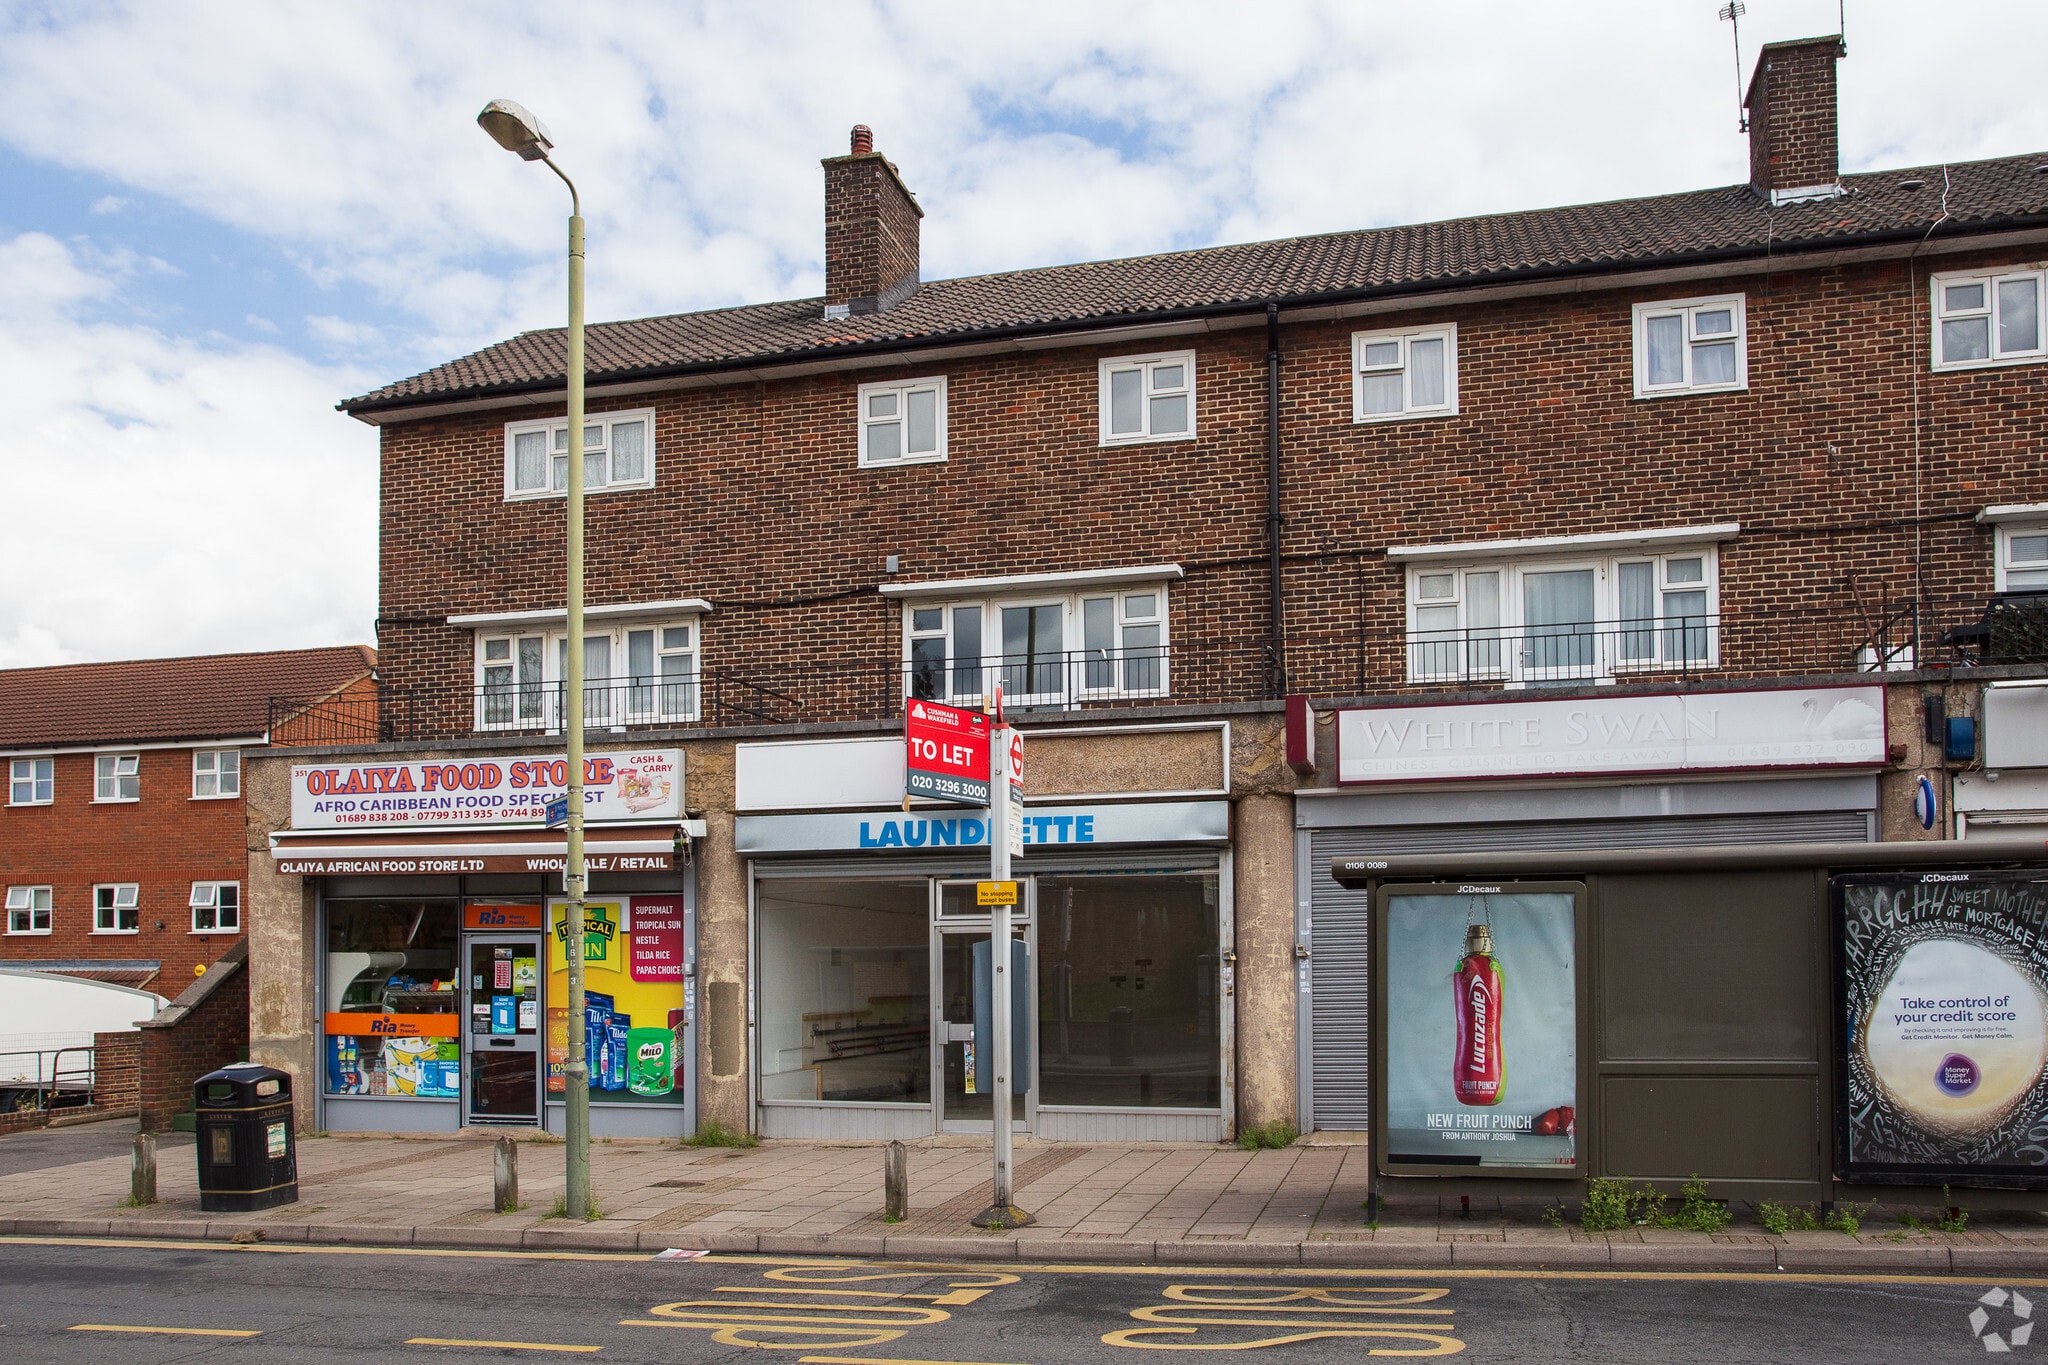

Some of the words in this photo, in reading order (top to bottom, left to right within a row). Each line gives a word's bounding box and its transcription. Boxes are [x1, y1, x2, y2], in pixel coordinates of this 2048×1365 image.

[927, 708, 954, 719] CUSHMAN
[927, 714, 959, 726] WAKEFIELD
[1360, 717, 1542, 752] WHITE
[1566, 708, 1720, 746] SWAN
[911, 737, 937, 760] TO
[943, 743, 973, 767] LET
[1728, 746, 1782, 758] 01689
[1837, 742, 1868, 754] 090
[630, 755, 655, 764] CASH
[656, 755, 664, 763] &
[1361, 759, 1440, 772] CHINESE
[1449, 756, 1523, 769] CUISINE
[1532, 755, 1555, 765] TO
[1565, 752, 1612, 764] TAKE
[1621, 750, 1672, 761] AWAY
[642, 764, 673, 773] CARRY
[307, 767, 416, 796] OLAIYA
[422, 763, 502, 792] FOOD
[911, 775, 933, 789] 020
[935, 779, 960, 794] 3296
[962, 783, 987, 798] 3000
[314, 801, 356, 813] AFRO
[360, 798, 451, 811] CARIBBEAN
[456, 796, 503, 808] FOOD
[509, 791, 605, 806] SPECIST
[336, 814, 367, 823] 01689
[369, 813, 388, 822] 838
[390, 813, 409, 821] 208
[417, 811, 449, 820] 07799
[452, 810, 471, 819] 313
[473, 809, 493, 818] 935
[501, 809, 528, 818] 0744
[860, 815, 1094, 848] LAUNDTTE
[280, 862, 325, 873] OLAIYA
[327, 861, 380, 873] AFRICAN
[382, 860, 416, 872] FOOD
[419, 860, 458, 872] STORE
[460, 859, 485, 871] LTD
[526, 858, 608, 871] WHOLALE
[620, 857, 668, 869] RETAIL
[1345, 862, 1364, 870] 0106
[1367, 861, 1387, 869] 0089
[1921, 874, 1969, 882] JCDecaux
[990, 890, 1013, 898] stopping
[1457, 885, 1501, 893] JCDecaux
[1950, 886, 1990, 908] SWEET
[479, 908, 506, 925] Ria
[636, 905, 673, 914] SUPERMALT
[636, 920, 666, 930] TROPICAL
[668, 920, 681, 929] SUN
[1891, 918, 1942, 938] TERRIBLE
[1943, 920, 1969, 932] RATES
[1970, 925, 1987, 936] NOT
[1986, 929, 2012, 945] GREAT
[1947, 904, 1962, 918] OF
[1965, 907, 2035, 949] MORTGAGE
[636, 936, 659, 945] NESTLE
[636, 951, 655, 960] TILDA
[655, 951, 670, 960] RICE
[636, 966, 657, 975] PAPAS
[657, 966, 681, 975] CHOICE
[1900, 997, 1935, 1009] Take
[1938, 996, 1990, 1009] control
[1994, 996, 2010, 1008] of
[371, 1016, 397, 1033] Ria
[1894, 1013, 1927, 1026] your
[1930, 1010, 1974, 1023] credit
[1977, 1012, 2016, 1022] score
[1470, 990, 1486, 1074] Lucozade
[640, 1047, 662, 1057] MILO
[1945, 1066, 1970, 1074] Money
[1462, 1080, 1477, 1090] FRUIT
[1478, 1080, 1497, 1090] PUNCH
[1427, 1114, 1454, 1128] NEW
[1456, 1114, 1489, 1129] FRUIT
[1492, 1114, 1532, 1129] PUNCH
[1442, 1132, 1460, 1140] FROM
[1461, 1132, 1490, 1141] ANTHONY
[1491, 1132, 1516, 1141] JOSHUA
